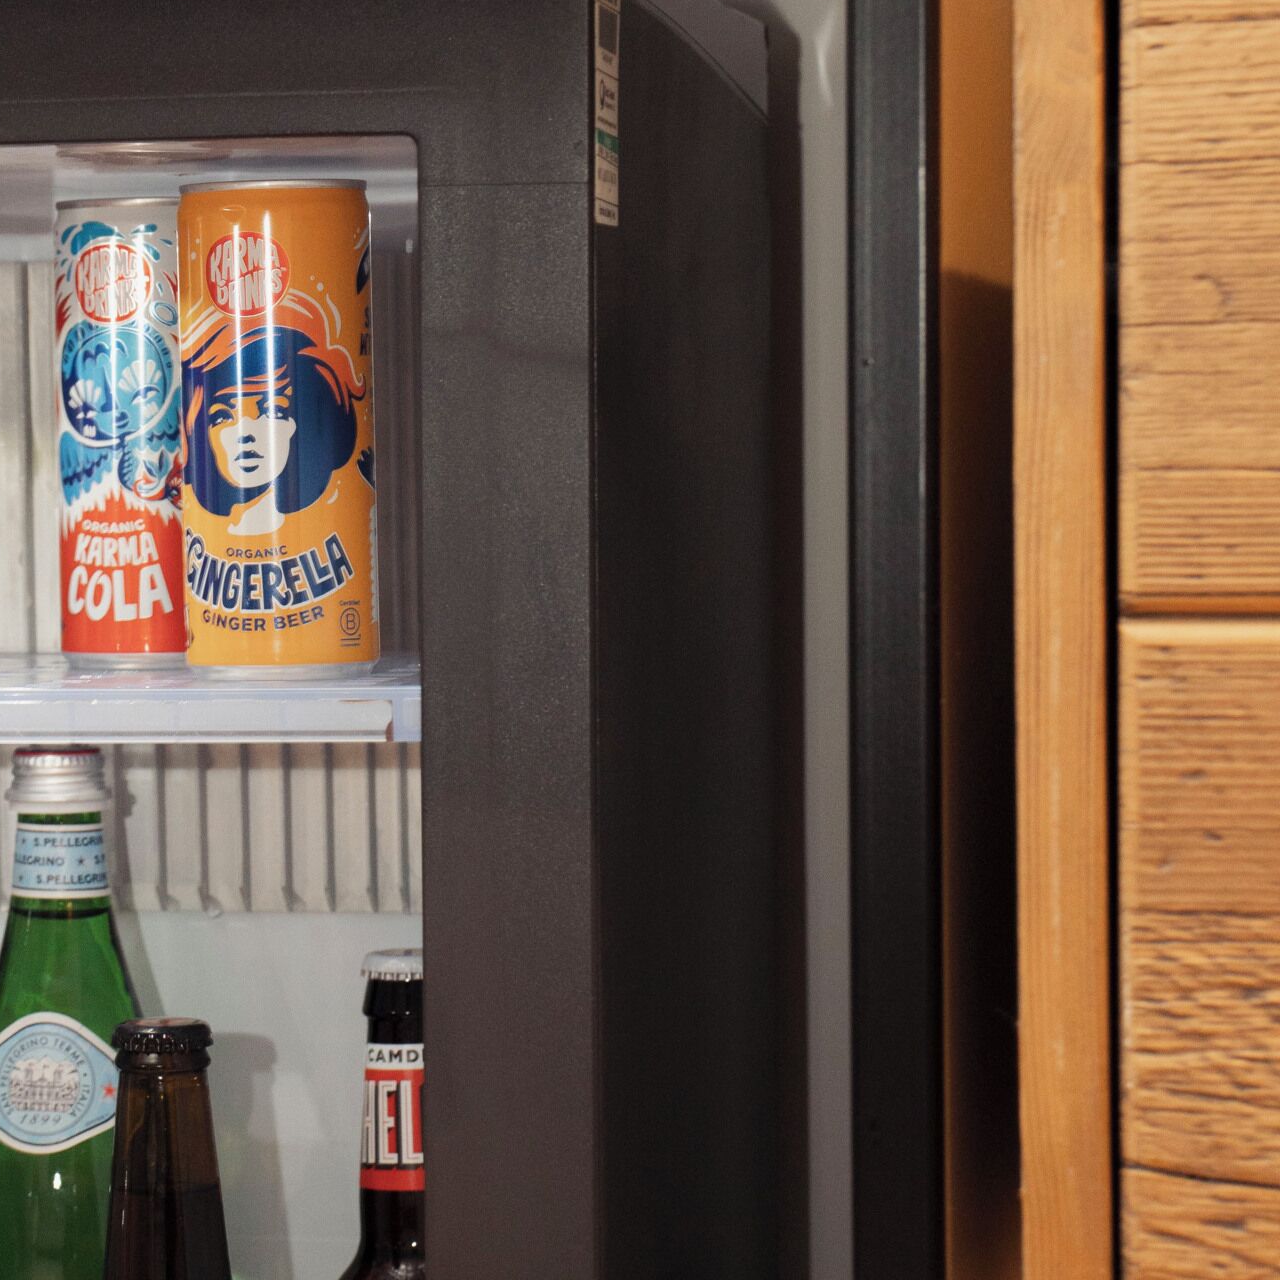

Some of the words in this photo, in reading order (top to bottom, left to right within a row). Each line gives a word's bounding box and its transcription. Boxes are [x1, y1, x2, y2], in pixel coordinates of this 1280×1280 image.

[211, 236, 280, 282] KARMA
[216, 267, 282, 310] DRINKS
[81, 518, 145, 534] ORGANIC
[73, 531, 160, 568] KARMA
[226, 545, 288, 560] ORGANIC
[184, 527, 355, 615] GINGERELLA
[69, 563, 174, 623] COLA
[202, 608, 266, 632] GINGER
[273, 606, 325, 630] BEER
[54, 1038, 85, 1066] TERME
[367, 1048, 424, 1064] CAMD
[0, 1092, 15, 1116] SAN
[69, 1084, 90, 1117] ITALIA
[361, 1079, 424, 1165] HEL
